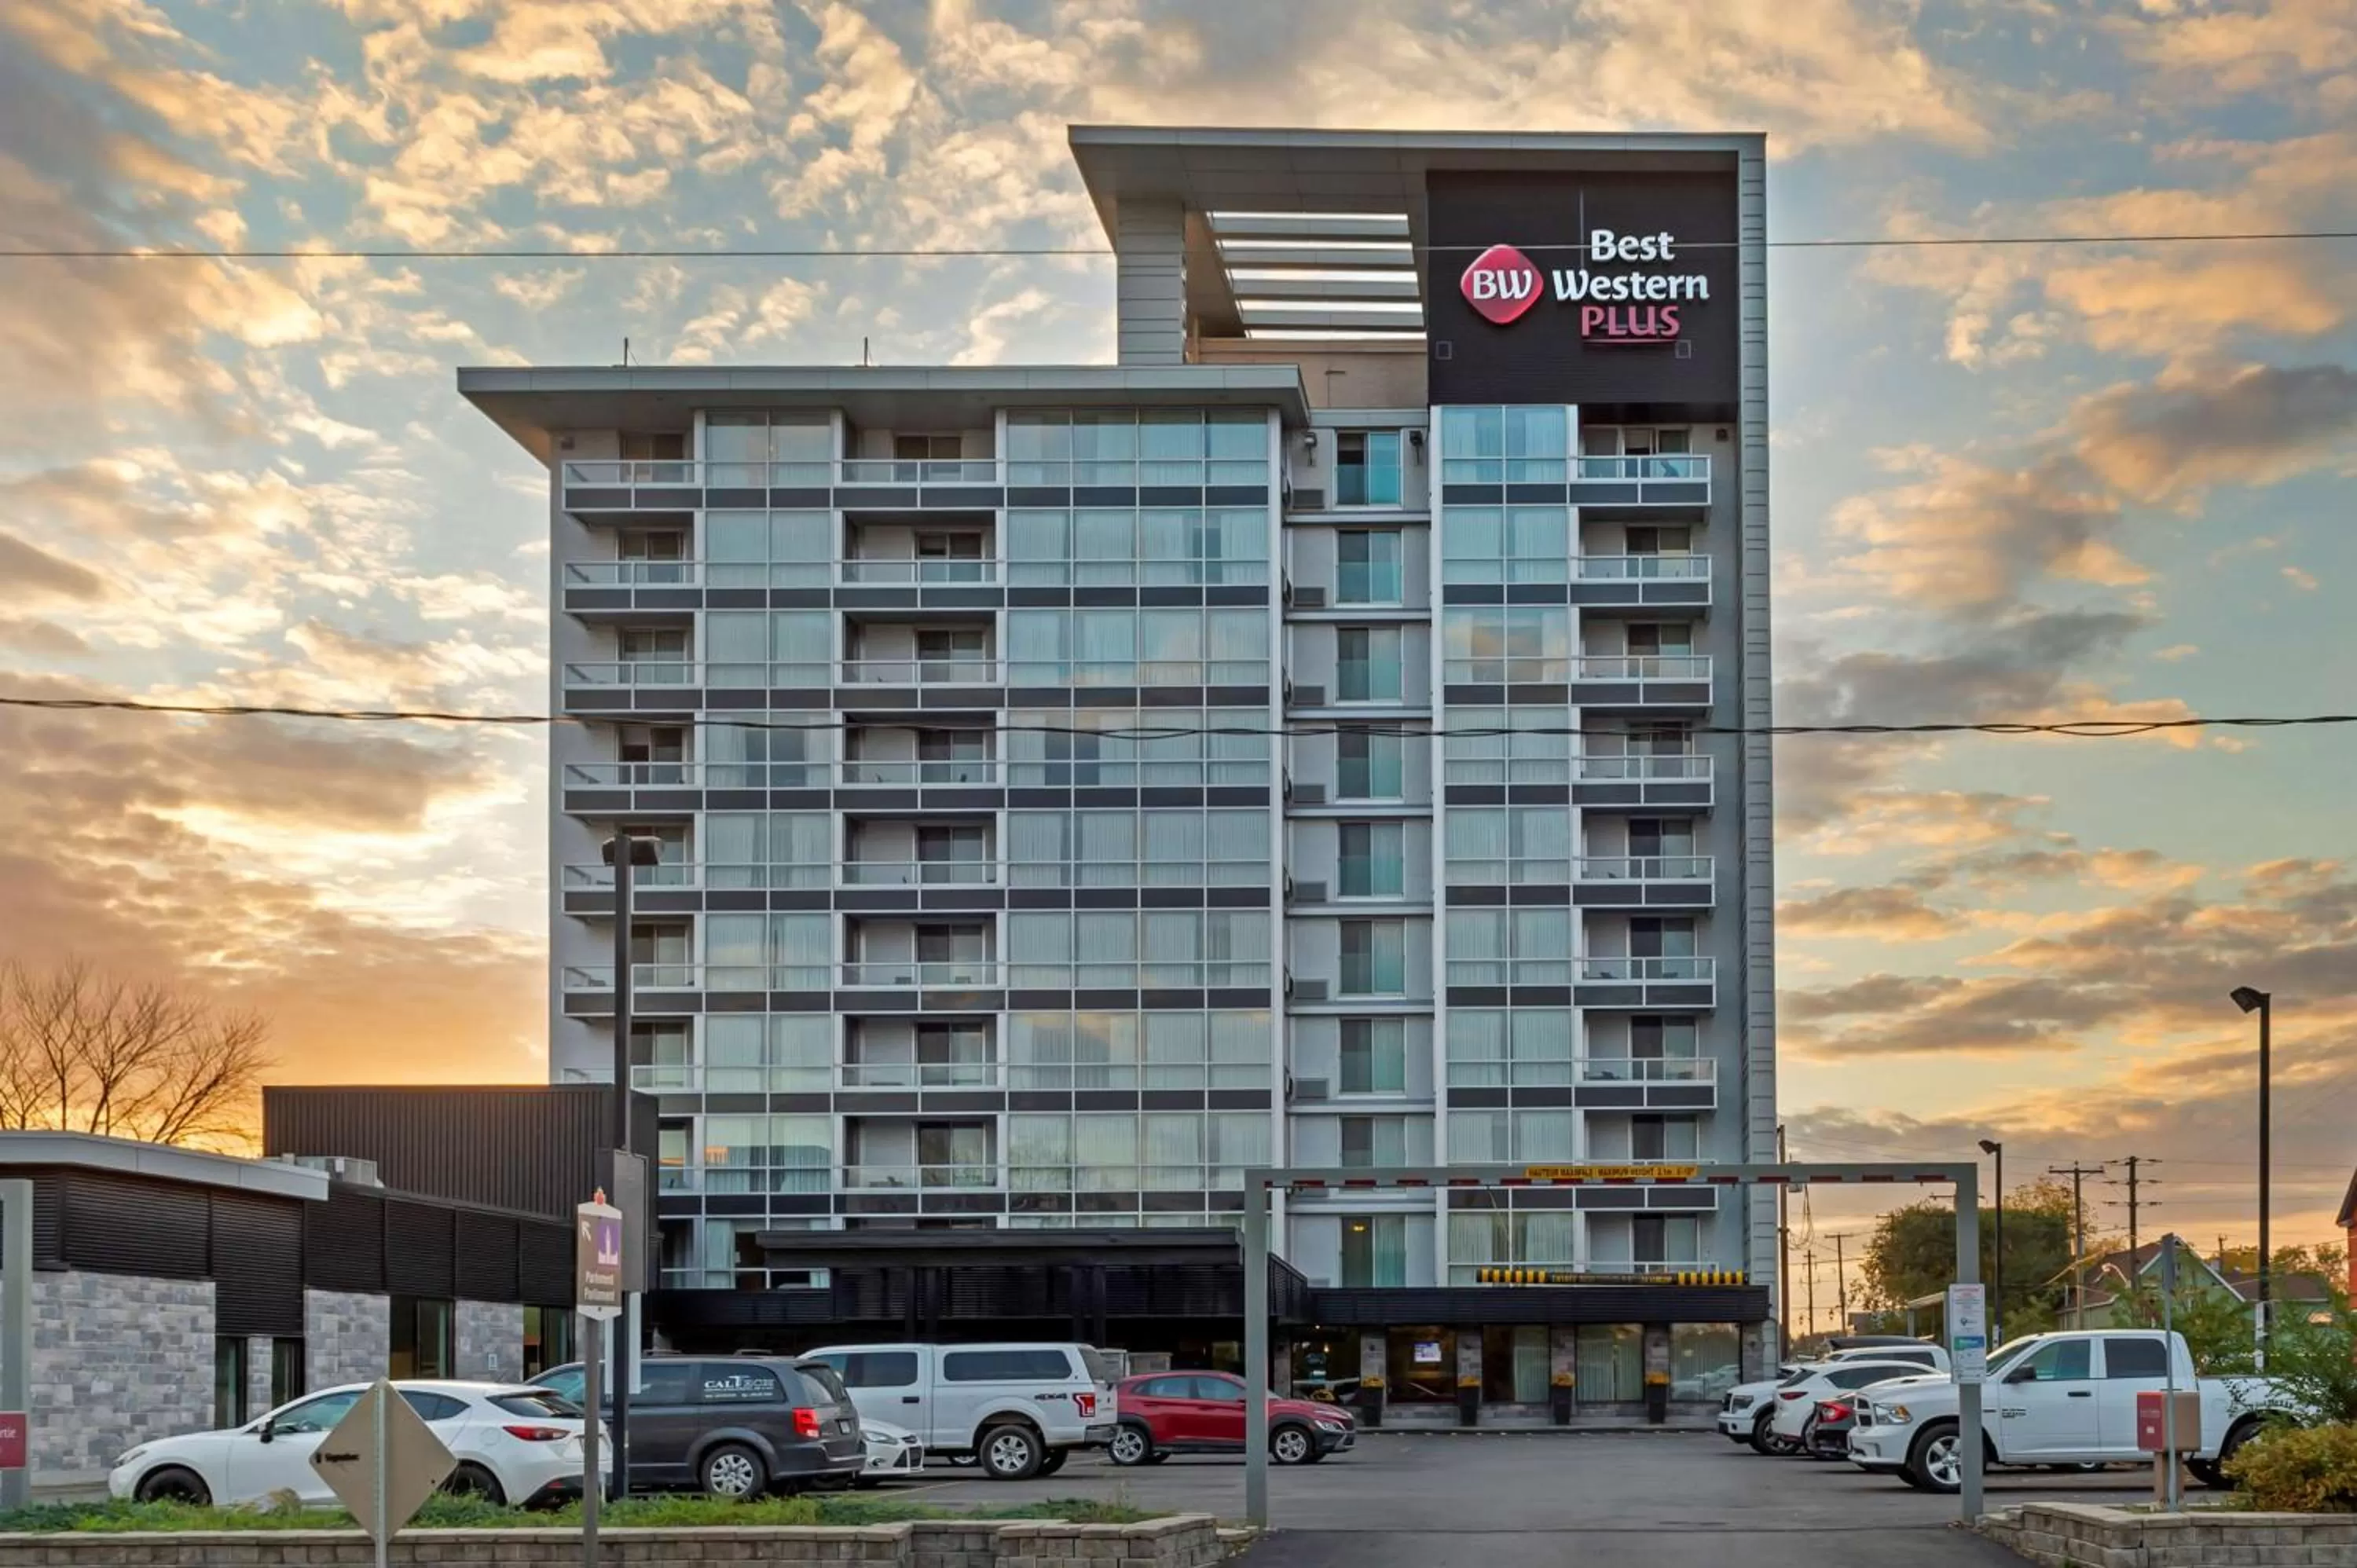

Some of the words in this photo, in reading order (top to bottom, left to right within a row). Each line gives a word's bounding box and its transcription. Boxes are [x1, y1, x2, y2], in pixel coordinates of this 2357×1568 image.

[1591, 229, 1676, 262] Best
[1472, 269, 1534, 299] BW
[1552, 269, 1710, 301] Western
[1581, 305, 1681, 337] PLUS
